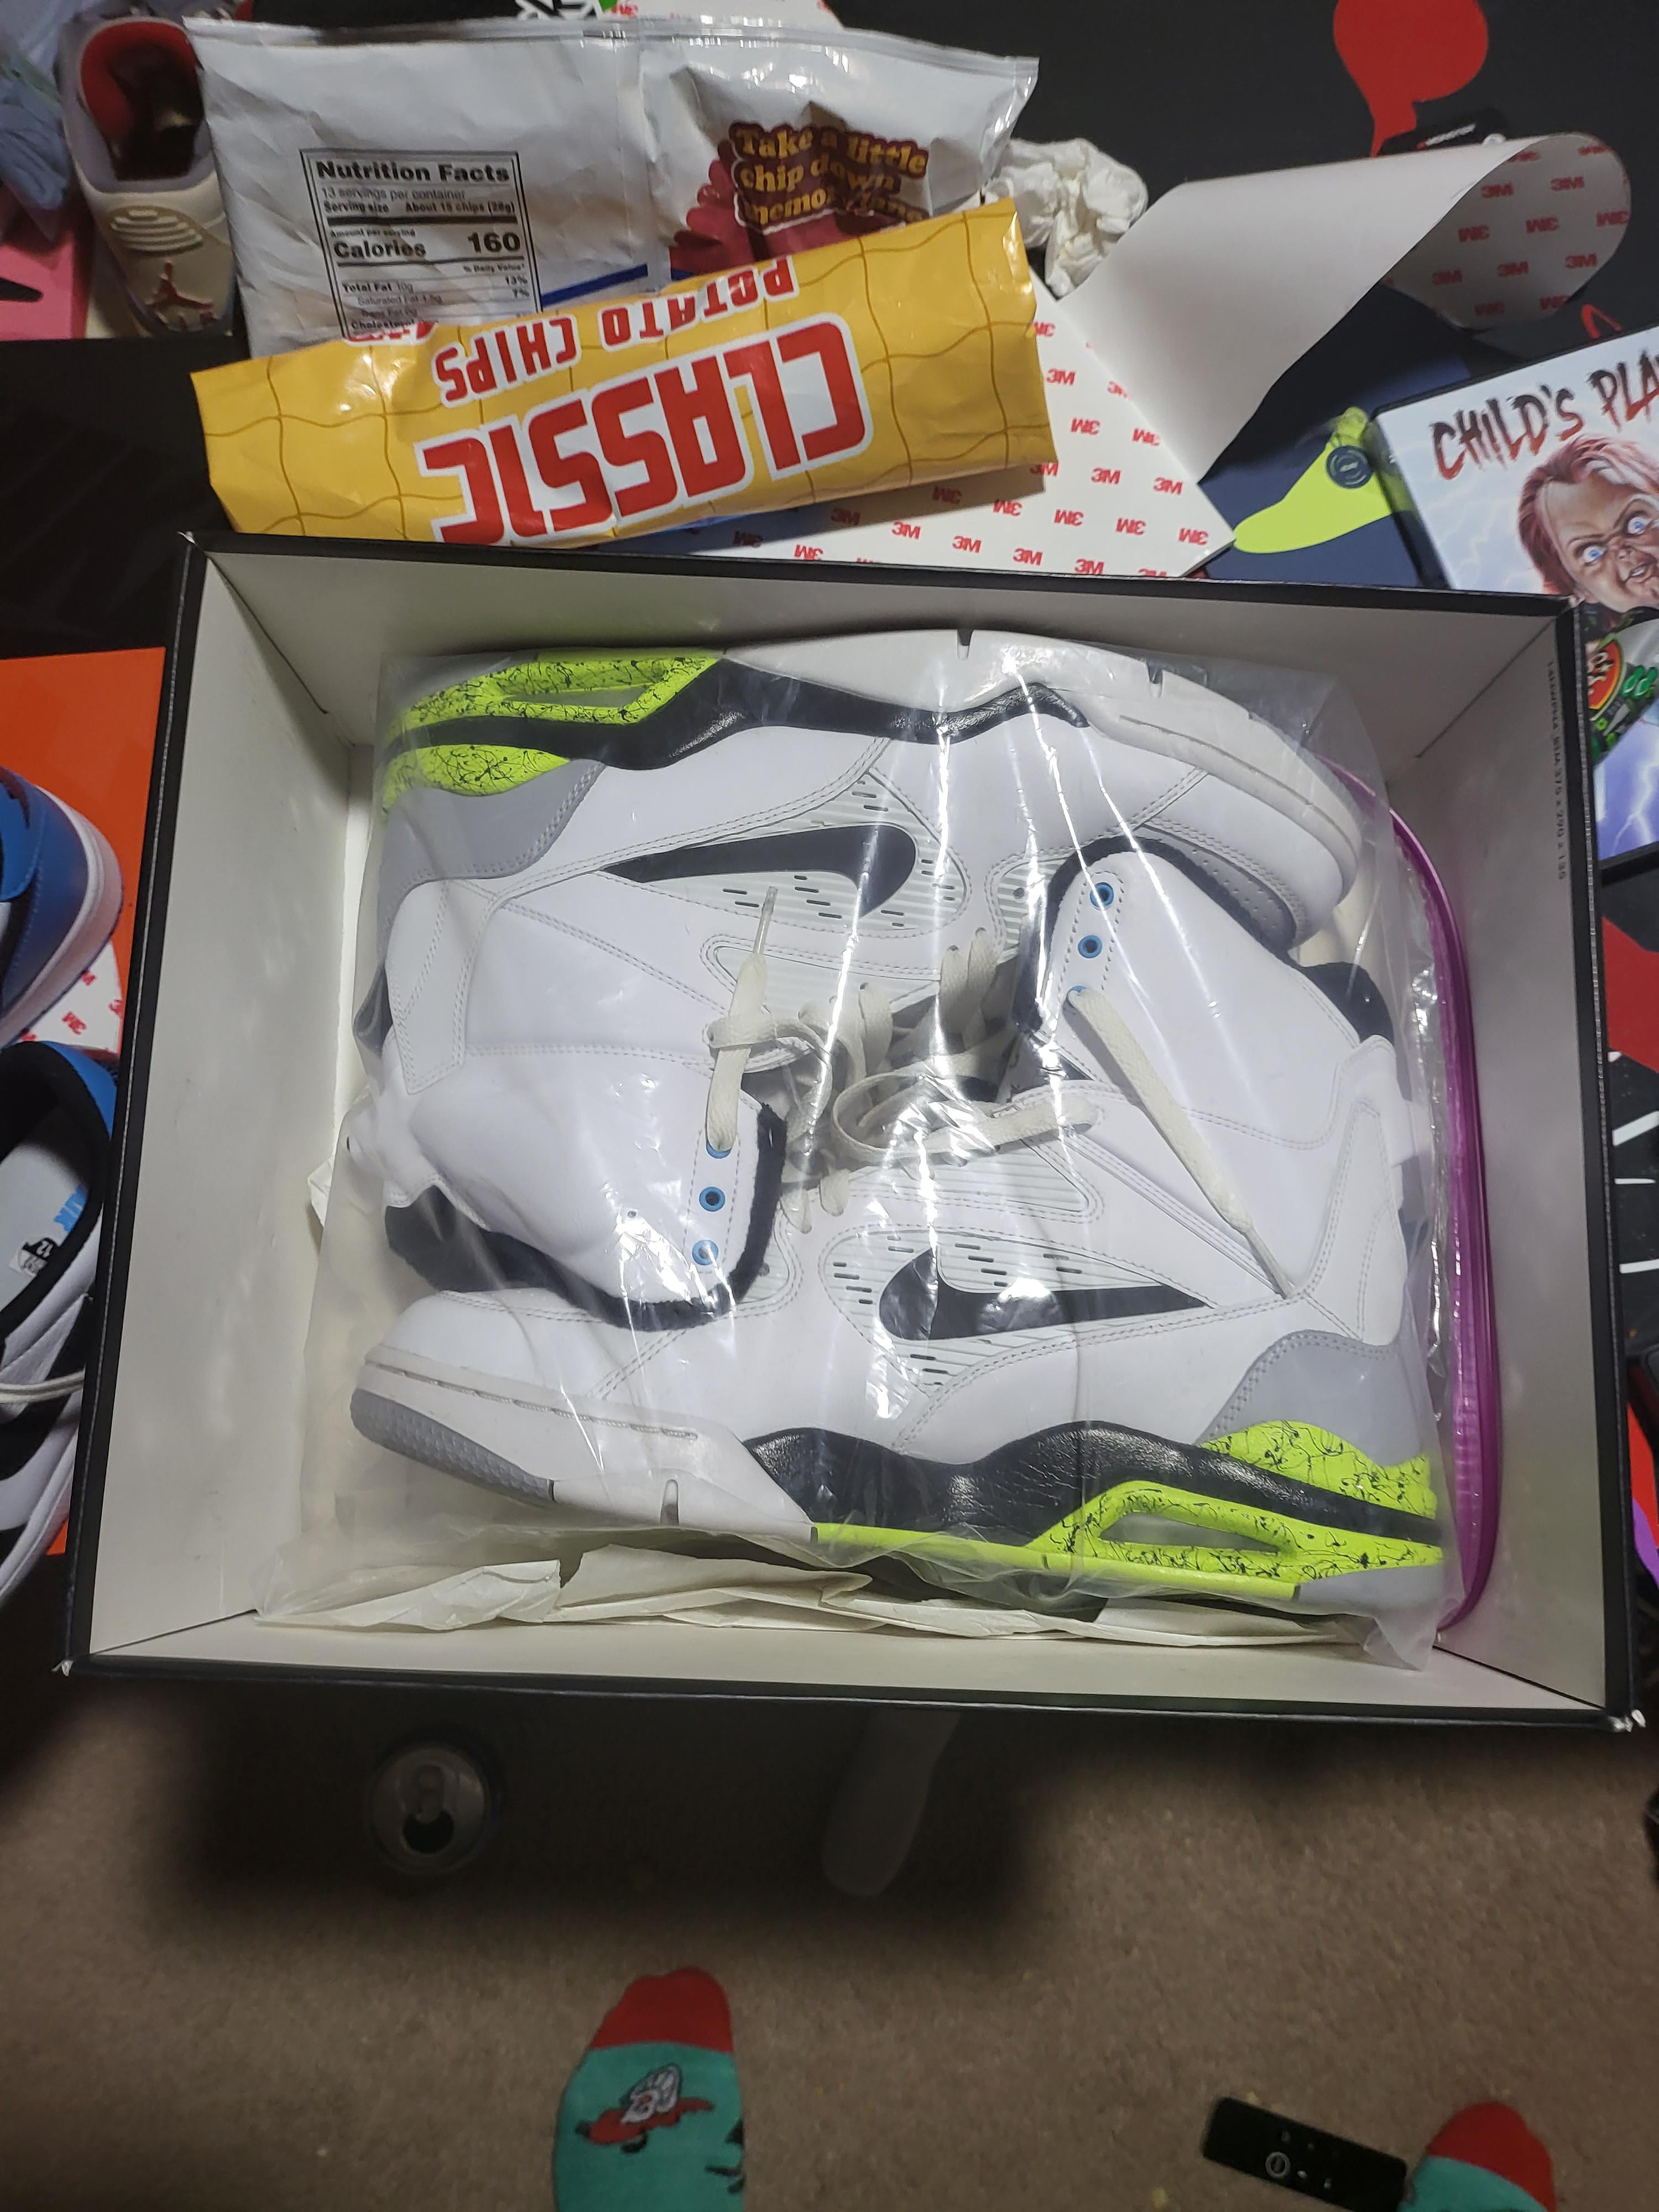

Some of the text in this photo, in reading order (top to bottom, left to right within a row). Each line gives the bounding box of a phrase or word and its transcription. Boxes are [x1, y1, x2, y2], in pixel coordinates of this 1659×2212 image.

[736, 128, 926, 175] Take a little
[316, 160, 509, 181] Nutrition Facts
[740, 165, 804, 192] chip
[1483, 184, 1513, 197] 3M
[1552, 176, 1584, 190] 3M
[338, 188, 387, 202] servings
[390, 190, 408, 202] per
[412, 189, 465, 200] container
[324, 200, 366, 213] Serving
[368, 201, 389, 212] size
[406, 202, 437, 212] About
[456, 201, 484, 213] chips
[1526, 217, 1557, 233] 3M
[1597, 210, 1628, 226] 3M
[331, 228, 365, 237] Amount
[383, 229, 416, 237] serving
[1459, 226, 1487, 241] 3M
[333, 232, 520, 258] Calories 160
[473, 264, 495, 273] Daily
[1567, 253, 1598, 268] 3M
[1500, 261, 1529, 277] 3M
[342, 283, 371, 293] Total
[374, 282, 392, 291] Fat
[358, 296, 401, 305] Saturated
[404, 295, 419, 304] Fat
[436, 259, 795, 401] POTATO CHIPS
[1046, 369, 1075, 384] 3M
[1430, 349, 1659, 480] CHILD'S PLA
[423, 322, 867, 544] CLASSIC
[1071, 418, 1100, 435] 3M
[1092, 468, 1120, 484] 3M
[1154, 478, 1183, 494] 3M
[993, 501, 1022, 515] 3M
[1055, 509, 1083, 526] 3M
[893, 521, 920, 539] 3M
[1116, 519, 1145, 535] 3M
[952, 536, 981, 553] 3M
[1179, 528, 1208, 545] 3M
[1014, 548, 1042, 566] 3M
[1075, 559, 1104, 575] 3M
[36, 1240, 54, 1258] 12
